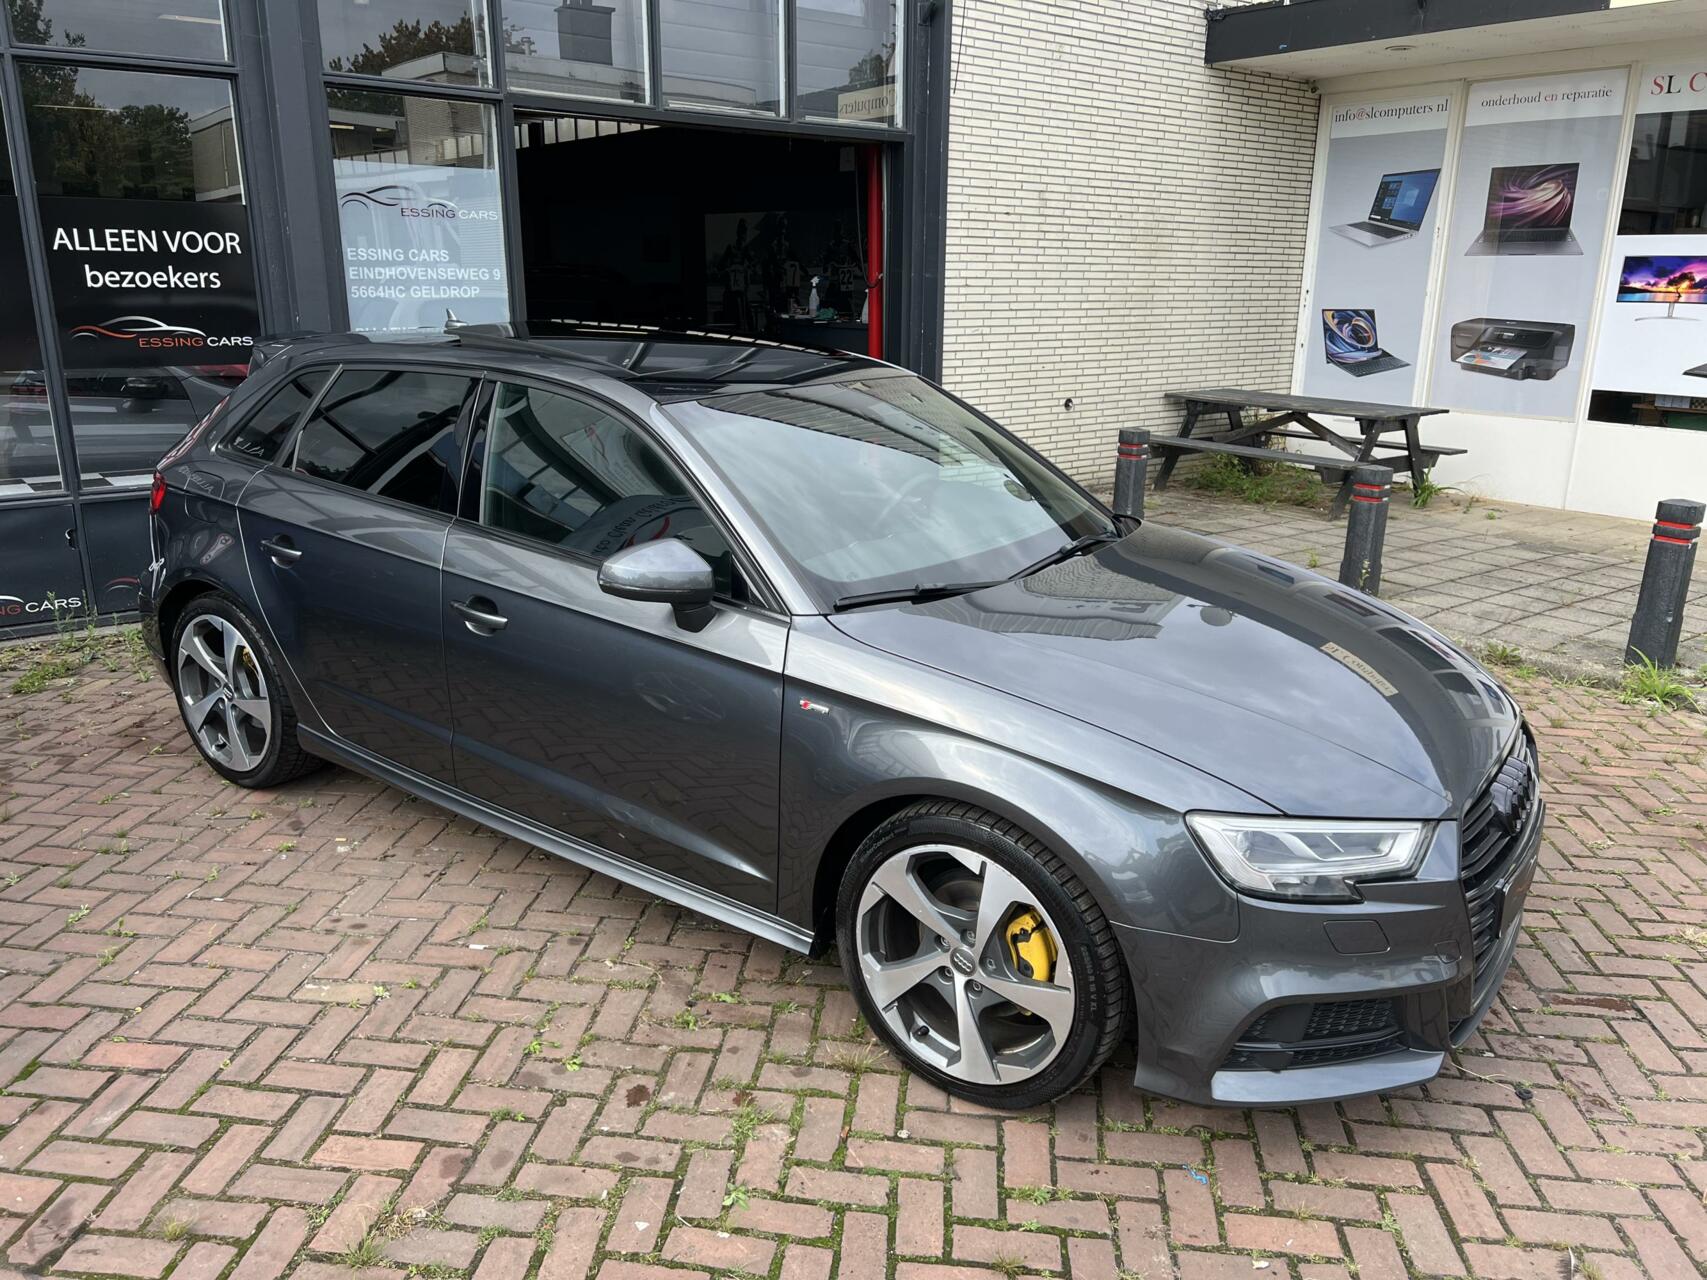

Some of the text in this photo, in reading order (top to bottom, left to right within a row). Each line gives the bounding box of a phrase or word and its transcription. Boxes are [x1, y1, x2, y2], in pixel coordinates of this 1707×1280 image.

[1650, 74, 1682, 96] SL
[1481, 85, 1613, 107] onderhoud en reparatie
[400, 207, 498, 220] ESSING CARS
[53, 227, 242, 254] ALLEEN VOOR
[347, 247, 449, 262] ESSING CARS
[84, 264, 221, 288] bezoekers
[349, 266, 501, 281] EINDHOVENSEWEG 9
[351, 286, 480, 298] 5664HC GELDROP
[138, 336, 253, 348] ESSING CARS
[25, 597, 82, 613] CARS
